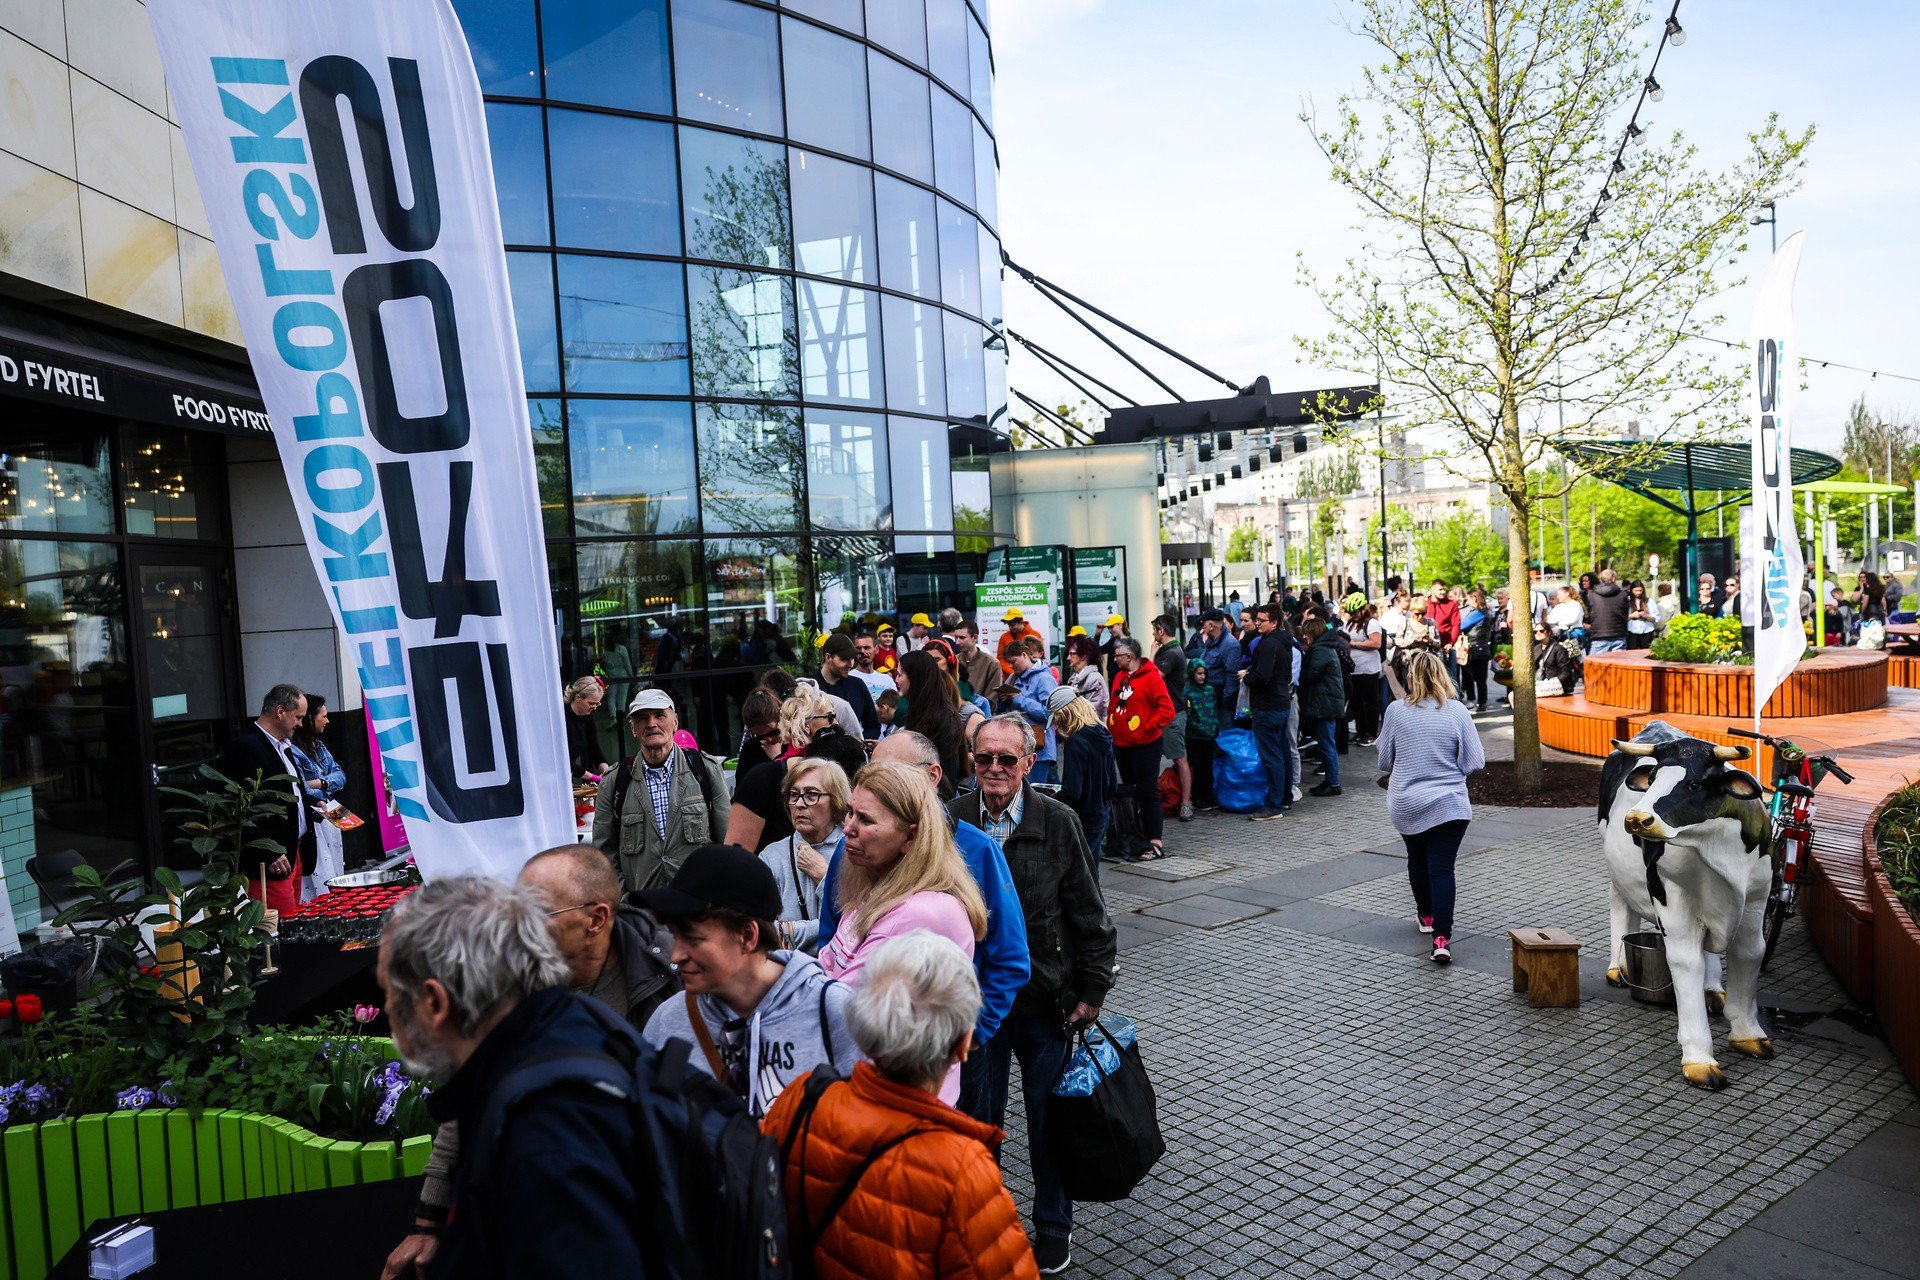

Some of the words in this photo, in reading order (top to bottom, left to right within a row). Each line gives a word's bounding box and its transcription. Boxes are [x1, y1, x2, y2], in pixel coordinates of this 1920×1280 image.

[23, 360, 105, 402] FYRTEL
[172, 393, 227, 425] FOOD
[980, 593, 1044, 602] PRZYRODNICZYCH
[986, 586, 1013, 595] ZESPÓŁ
[1015, 585, 1037, 594] SZKÓŁ
